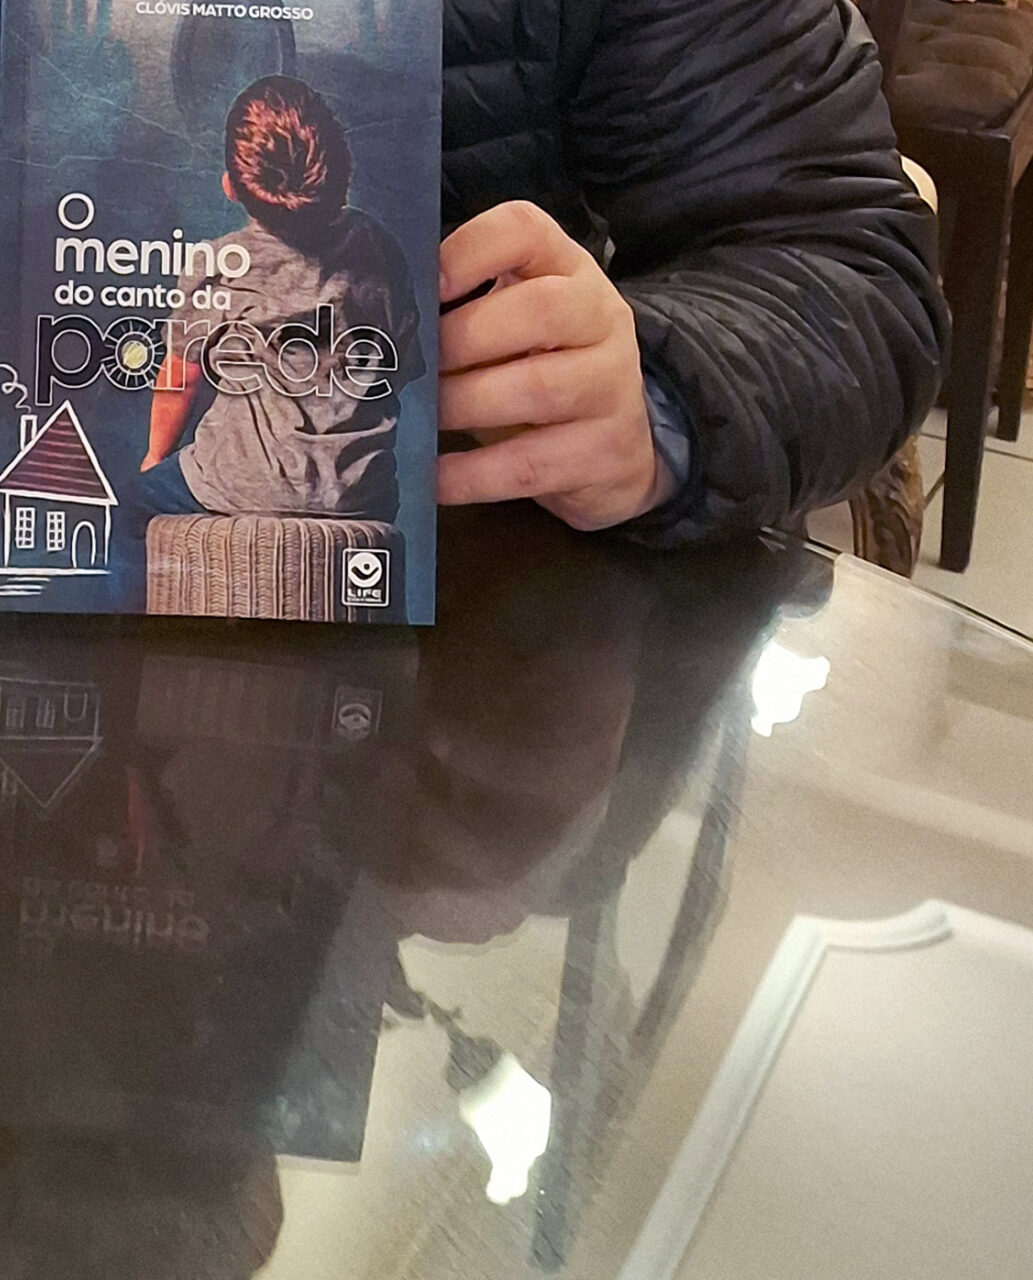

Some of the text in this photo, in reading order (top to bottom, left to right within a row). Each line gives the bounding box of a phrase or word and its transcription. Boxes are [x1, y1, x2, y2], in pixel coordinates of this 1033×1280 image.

[135, 0, 314, 20] CLÓVIS MATTO GROSSO
[57, 192, 95, 231] O
[54, 228, 251, 279] menino
[54, 280, 232, 311] do canto da
[35, 304, 399, 407] parede
